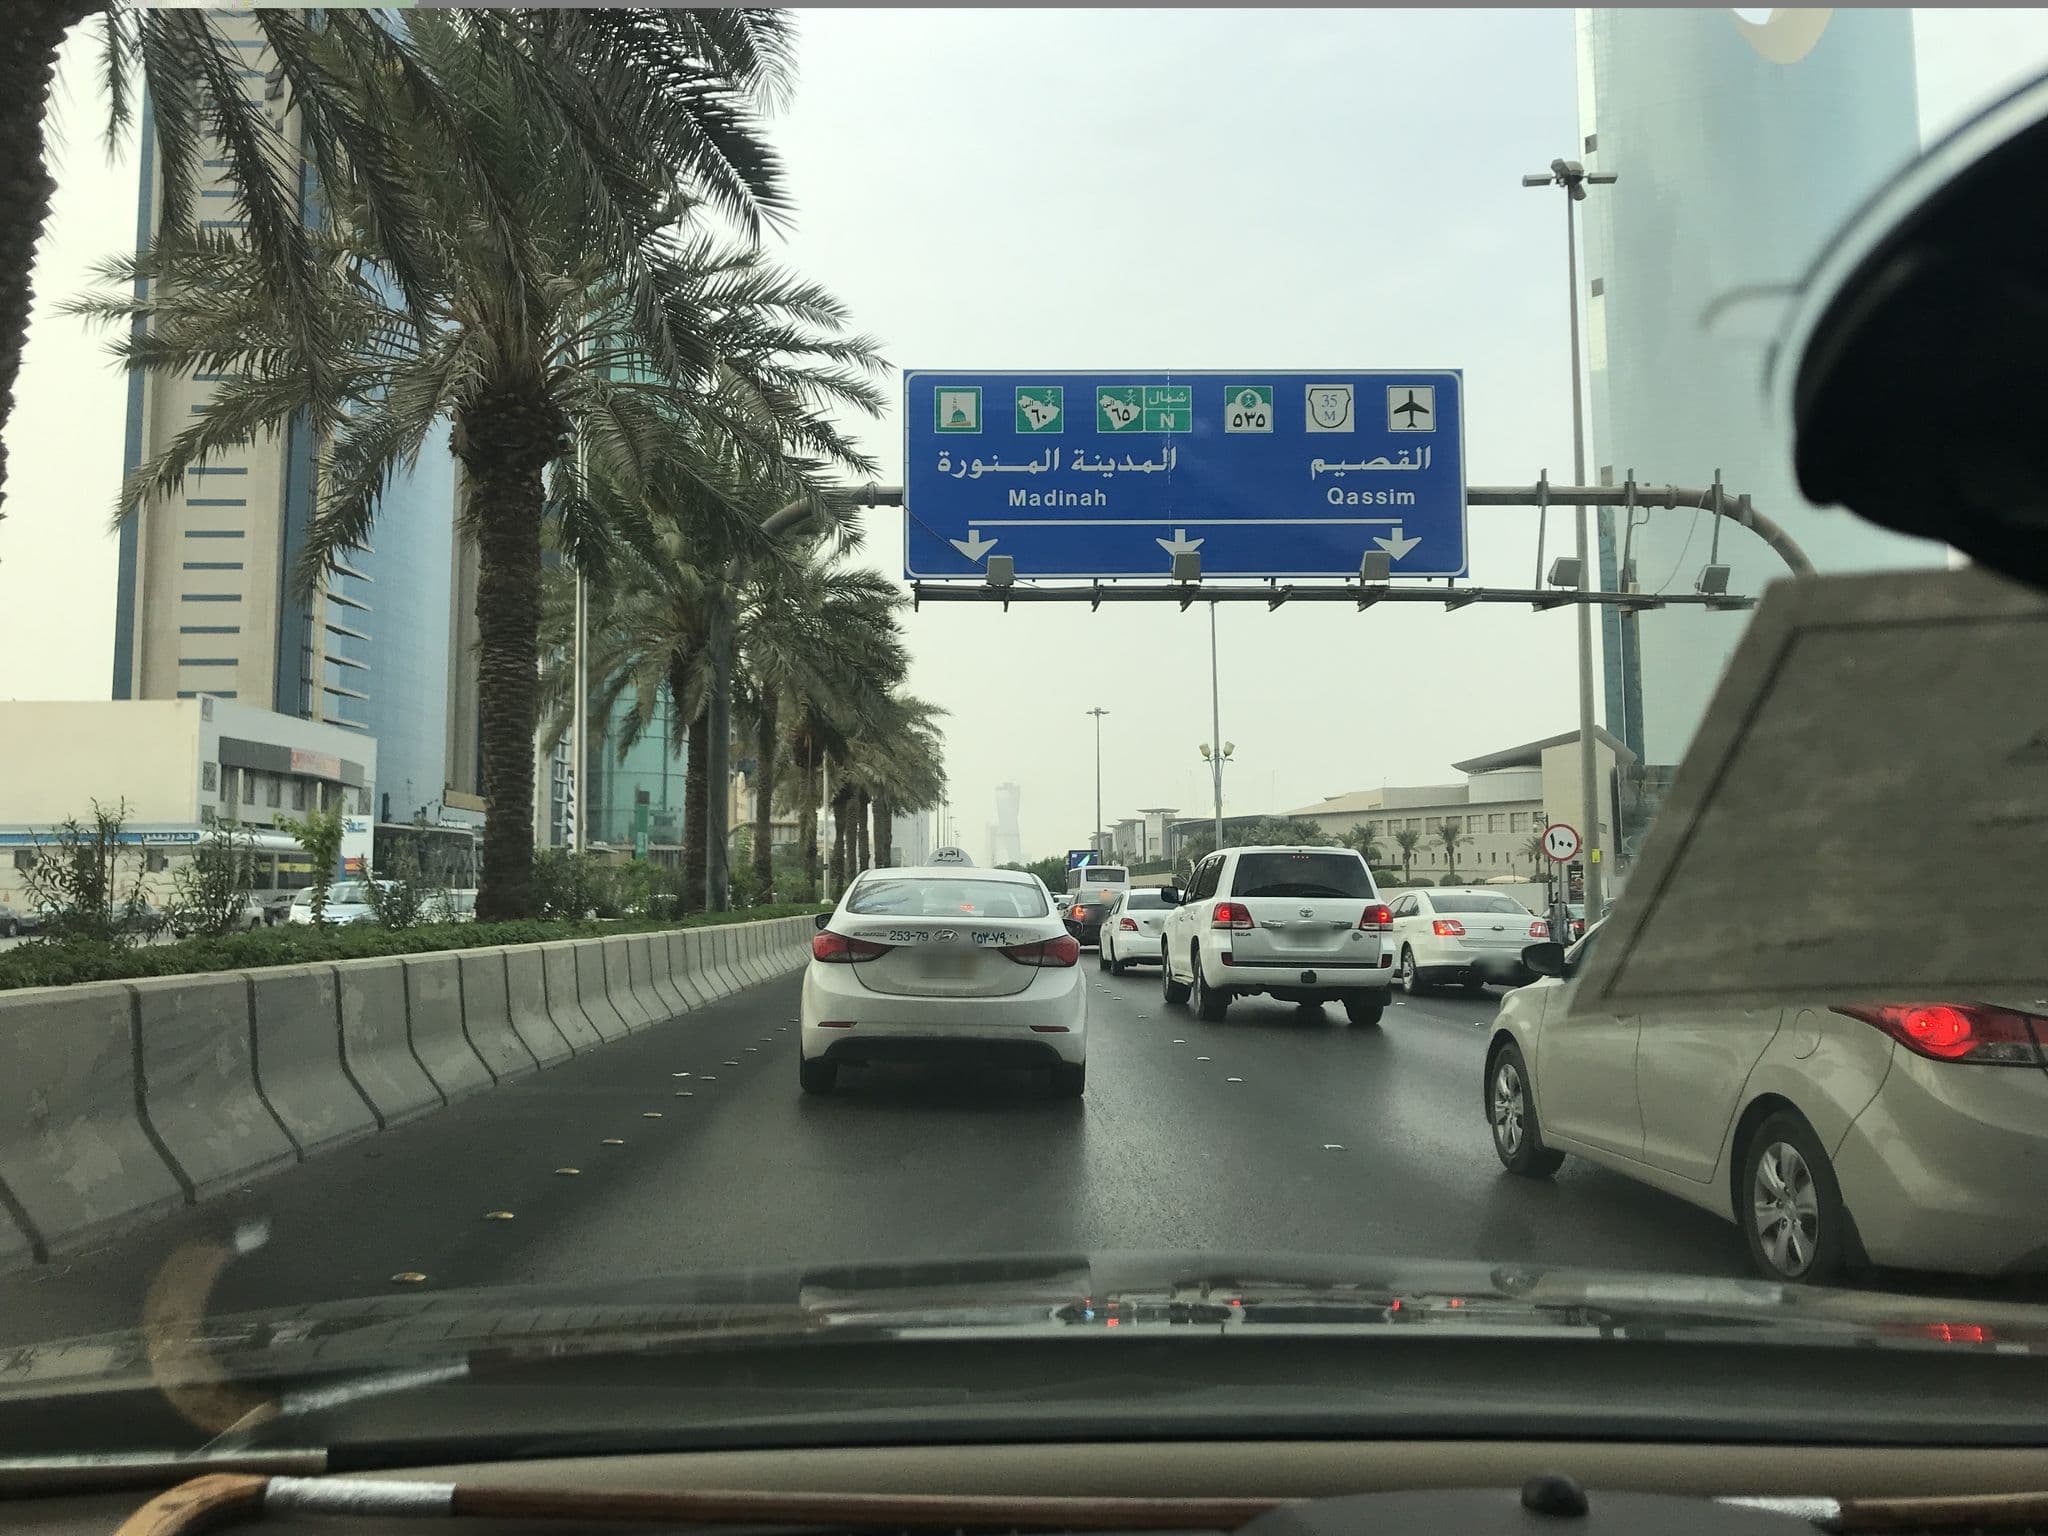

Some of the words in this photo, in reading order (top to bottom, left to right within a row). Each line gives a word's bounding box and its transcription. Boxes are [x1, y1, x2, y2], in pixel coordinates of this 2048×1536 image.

[1148, 390, 1187, 405] شمال
[1321, 394, 1338, 409] 35
[1031, 408, 1047, 424] ٦٠
[1111, 407, 1131, 422] ٦٥
[1160, 412, 1175, 429] N
[1324, 411, 1336, 421] M
[937, 446, 1060, 479] المنورة
[1071, 446, 1177, 479] المدينة
[1310, 445, 1432, 481] القصيم
[1008, 489, 1107, 507] Madinah
[1327, 487, 1416, 505] Qassim
[1549, 832, 1573, 850] ١٠٠
[889, 930, 929, 941] 253-79
